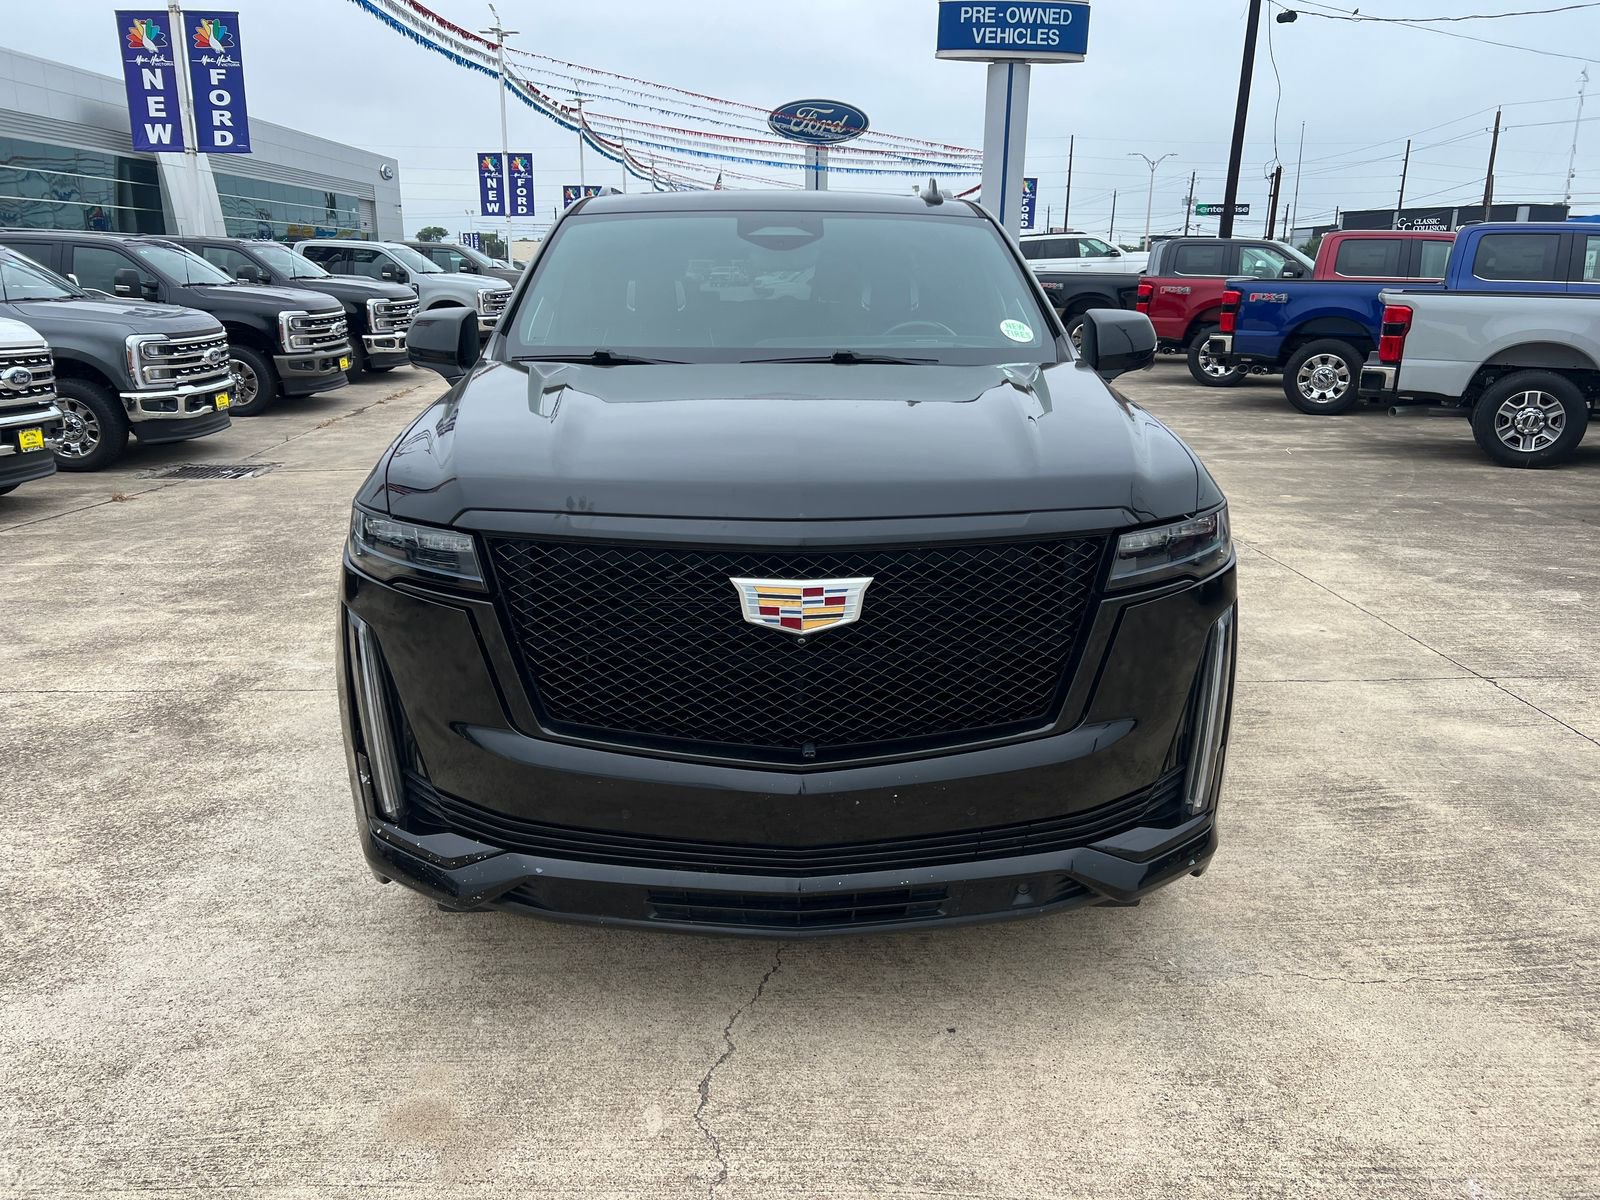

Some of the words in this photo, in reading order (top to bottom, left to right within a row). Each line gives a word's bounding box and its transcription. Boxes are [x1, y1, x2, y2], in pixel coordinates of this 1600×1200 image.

[960, 6, 1073, 26] PRE-OWNED
[972, 27, 1060, 46] VEHICLES
[141, 68, 172, 144] NEW
[208, 68, 234, 146] FORD
[790, 107, 849, 133] Ford
[486, 177, 500, 213] NEW
[516, 178, 528, 214] FORD
[1020, 198, 1030, 227] FORD
[1249, 292, 1288, 303] FX4
[1004, 321, 1025, 330] NEW
[1007, 329, 1032, 339] TIRES
